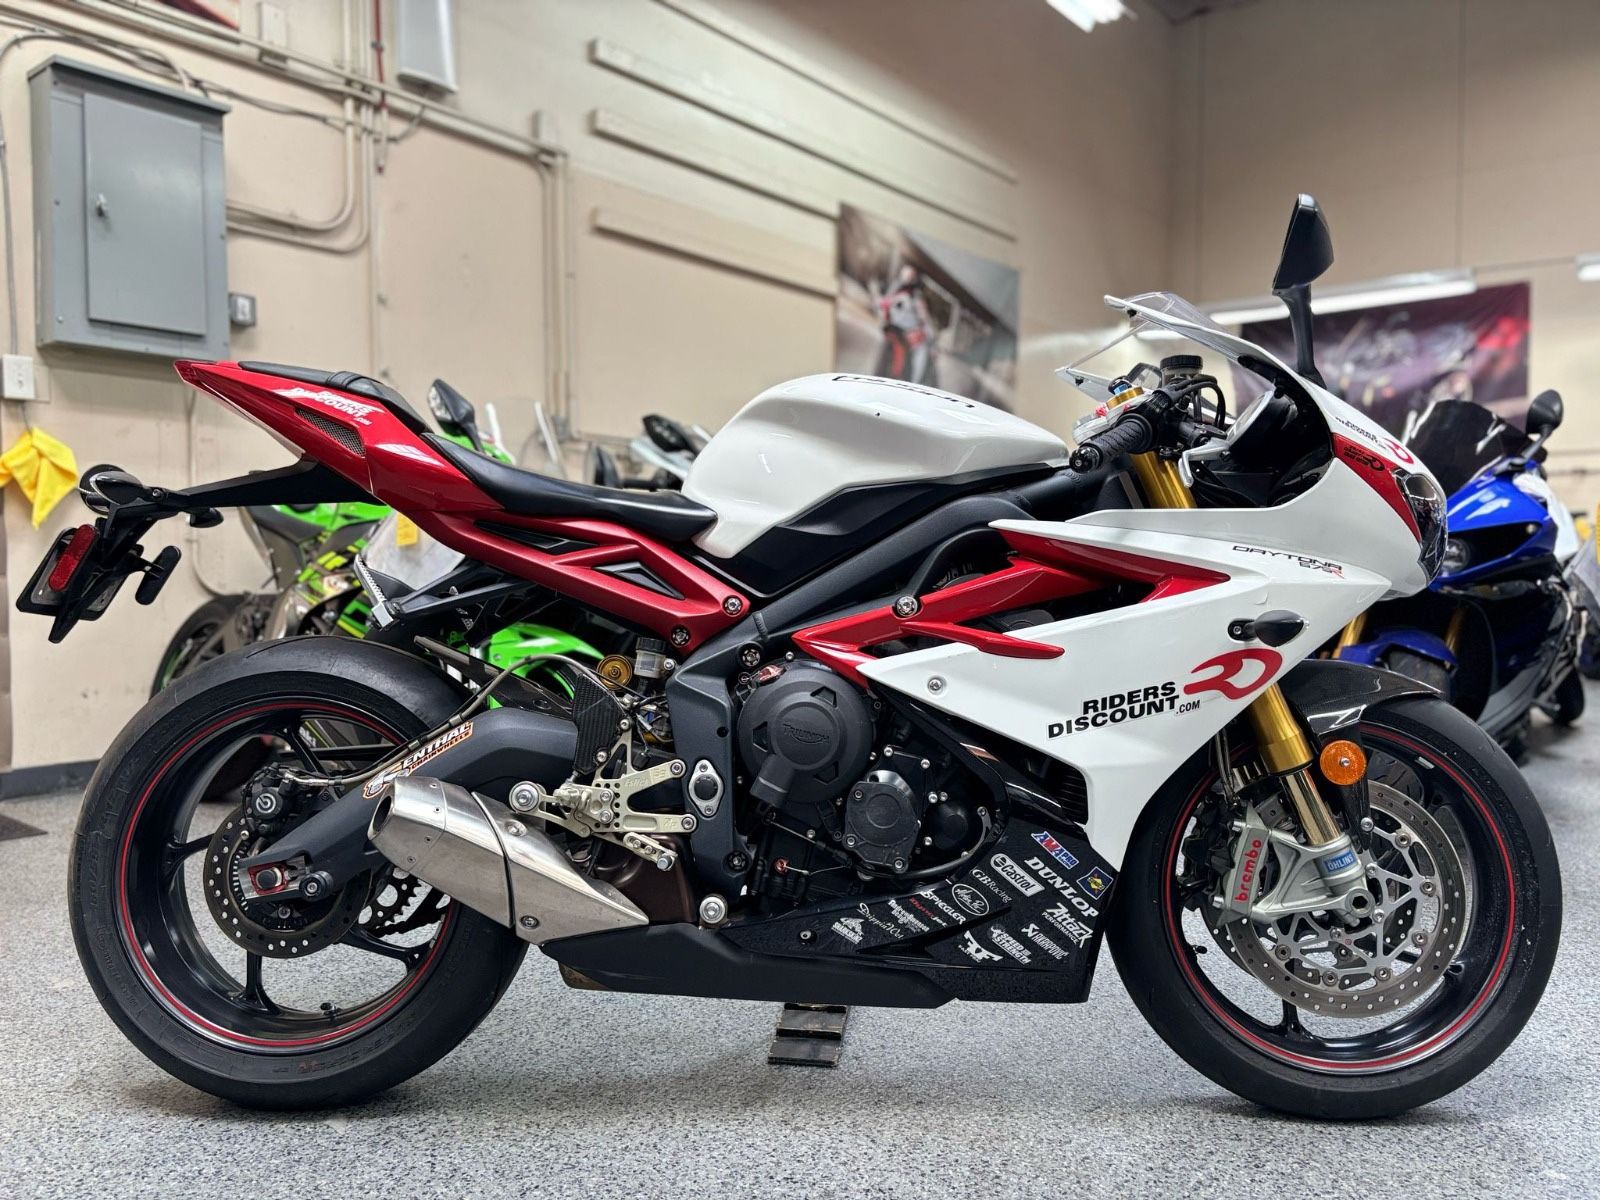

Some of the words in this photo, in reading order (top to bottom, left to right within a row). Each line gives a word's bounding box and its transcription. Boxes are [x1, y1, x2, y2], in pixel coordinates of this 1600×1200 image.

[1232, 545, 1342, 571] DAYTONA
[1048, 695, 1180, 739] DISCOUNT
[1175, 700, 1201, 715] .COM
[1082, 681, 1176, 716] RIDERS
[411, 731, 471, 771] CHAINWHEELS
[1001, 864, 1036, 891] Castrol
[1024, 856, 1099, 917] DUNLOP
[1234, 839, 1262, 902] brembo
[922, 888, 966, 925] SPIEGLER
[1046, 902, 1094, 948] Attack
[1001, 931, 1025, 951] SPEED
[1042, 911, 1079, 944] PERFORMANCE
